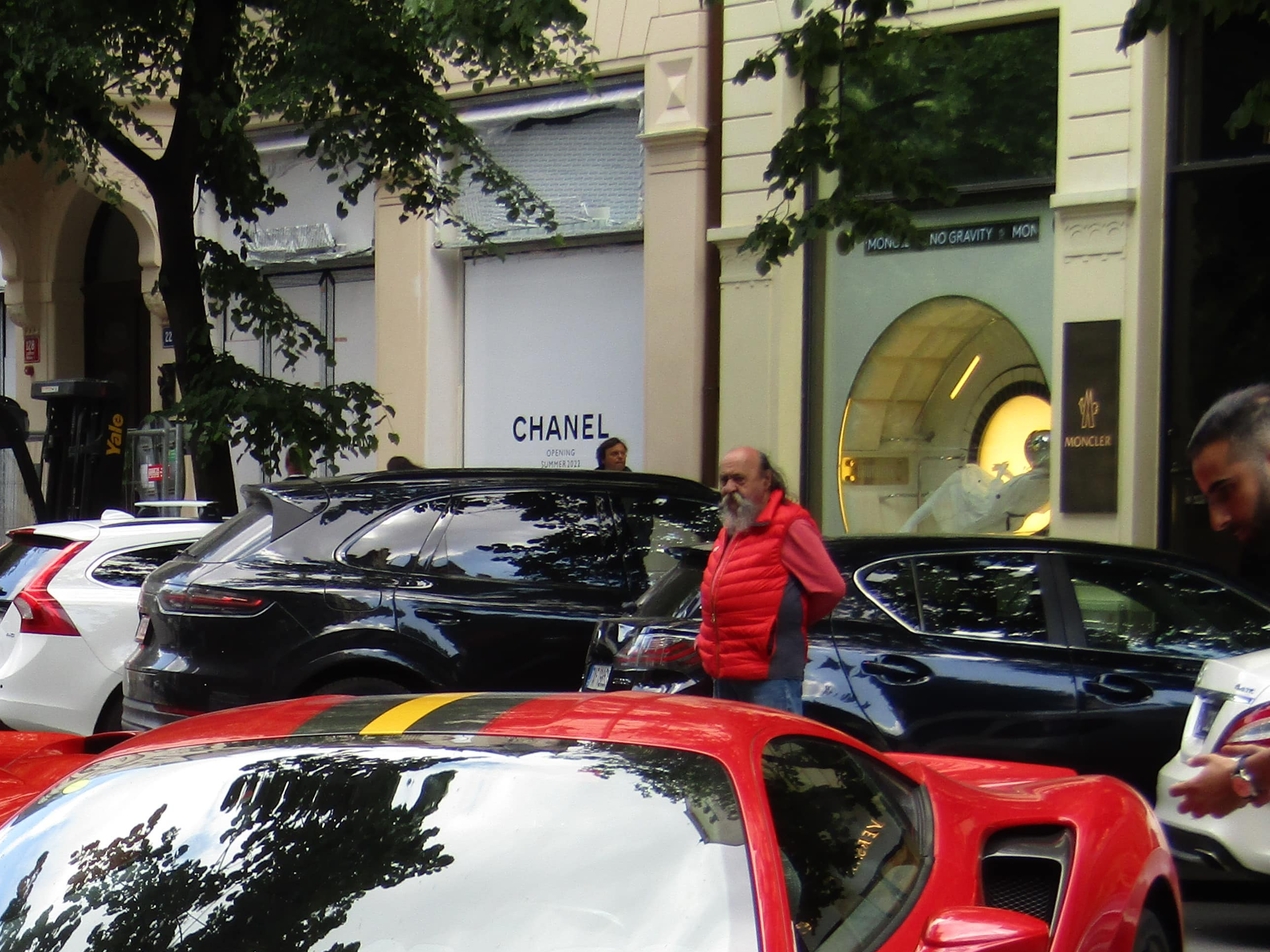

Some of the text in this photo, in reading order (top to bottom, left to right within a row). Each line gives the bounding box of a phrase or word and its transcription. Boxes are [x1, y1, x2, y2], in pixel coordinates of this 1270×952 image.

[929, 232, 946, 246] NO
[948, 227, 994, 244] GRAVITY
[105, 413, 124, 456] Yale
[512, 413, 610, 443] CHANEL
[1064, 435, 1112, 448] MONCLER
[546, 448, 576, 458] OPENING
[541, 460, 566, 469] SUMMER
